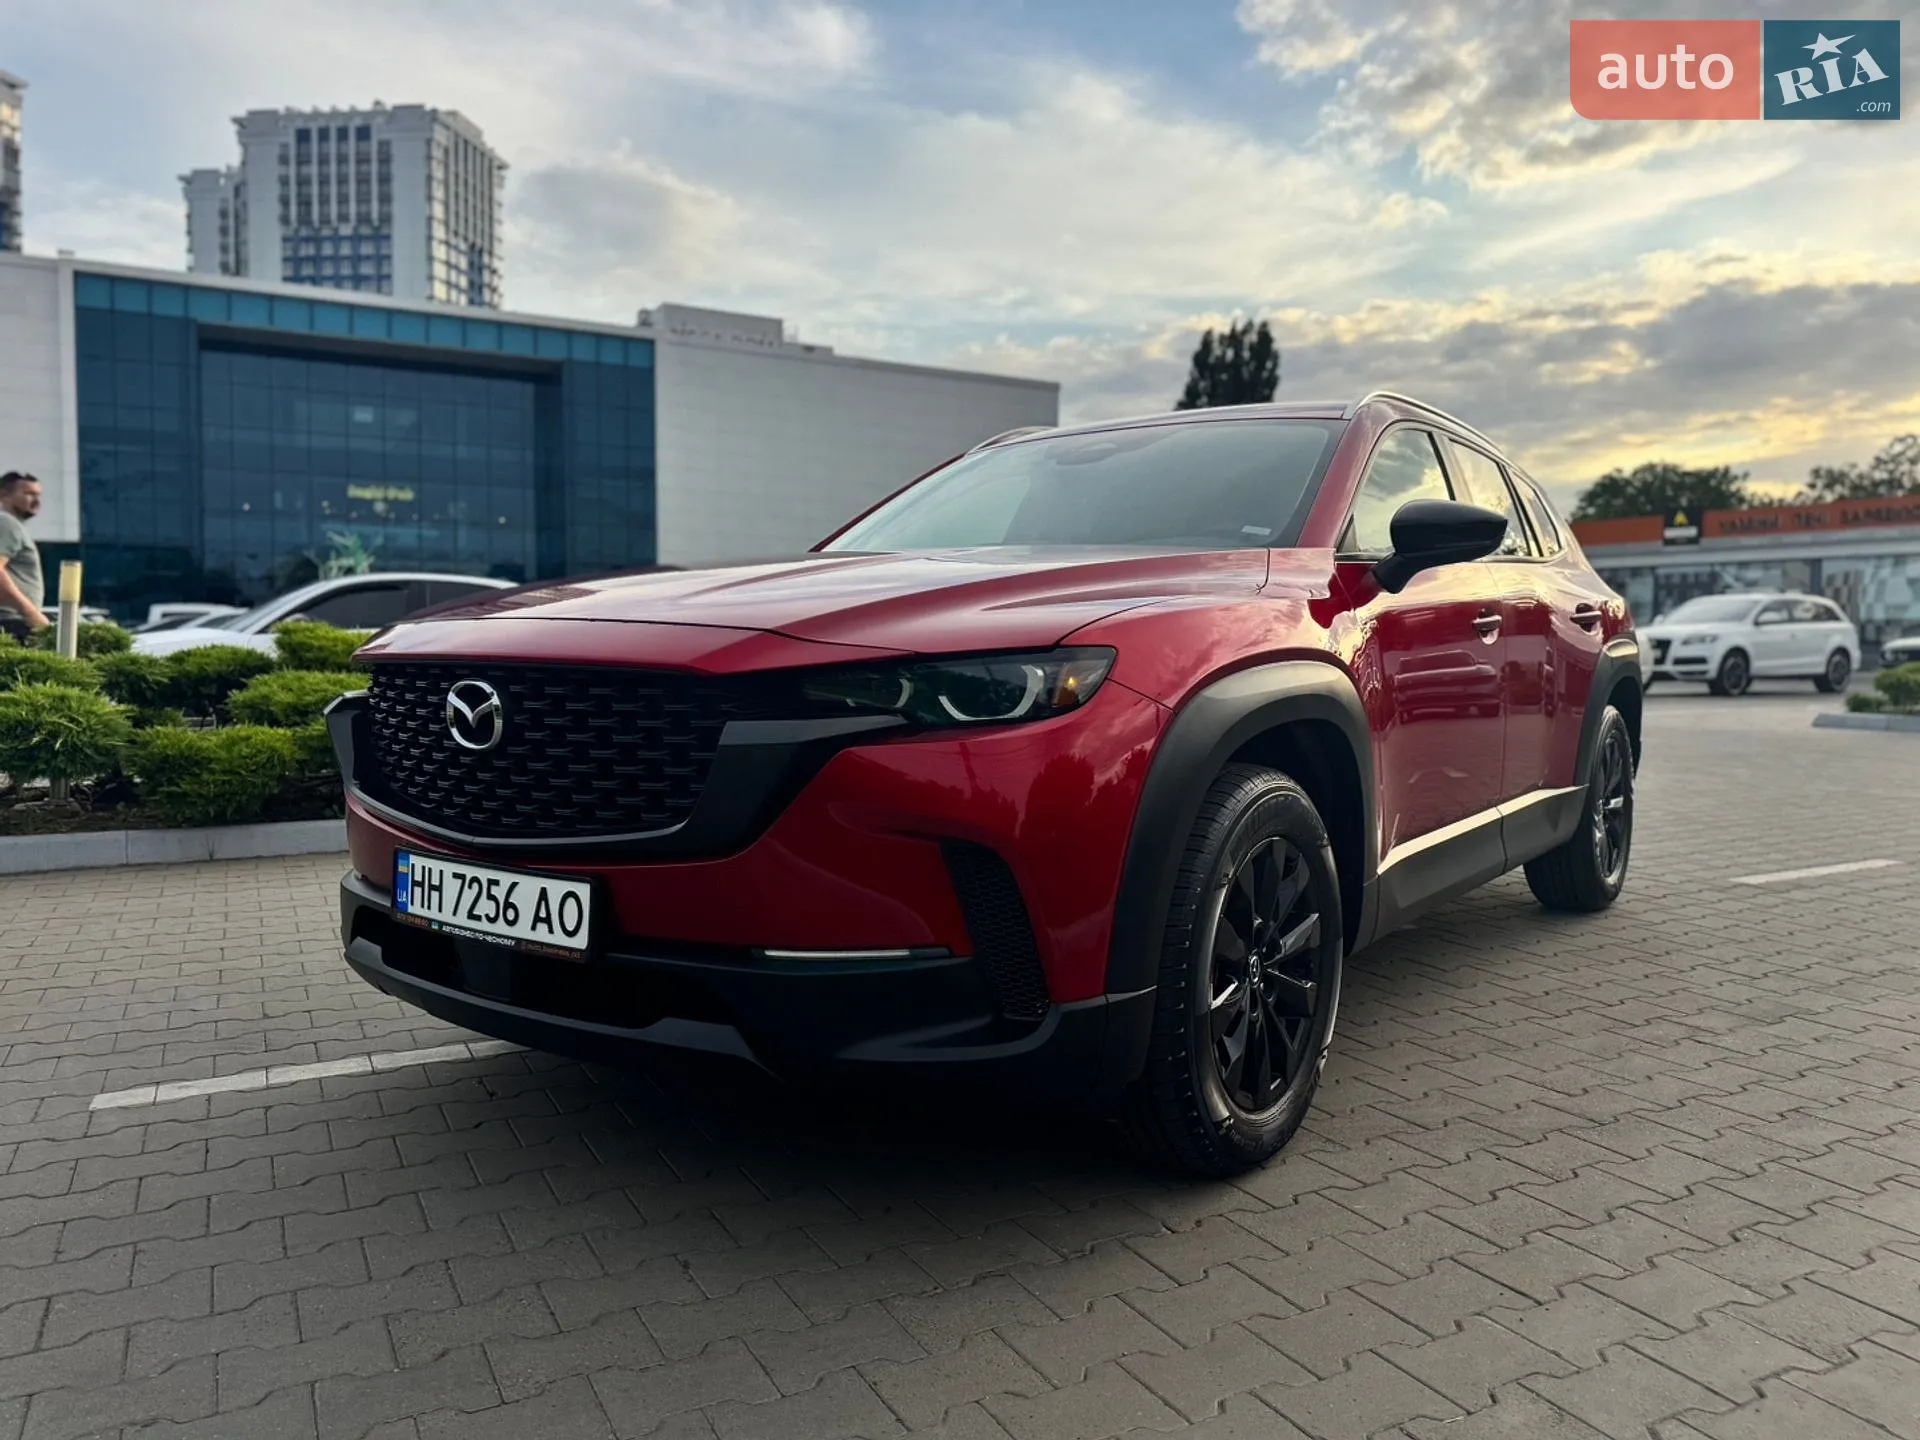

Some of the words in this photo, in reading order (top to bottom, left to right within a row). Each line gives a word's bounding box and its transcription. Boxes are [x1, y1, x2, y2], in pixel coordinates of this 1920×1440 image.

[397, 887, 408, 903] UA
[410, 862, 444, 913] HH
[452, 872, 520, 927] 7256
[530, 886, 584, 938] AO
